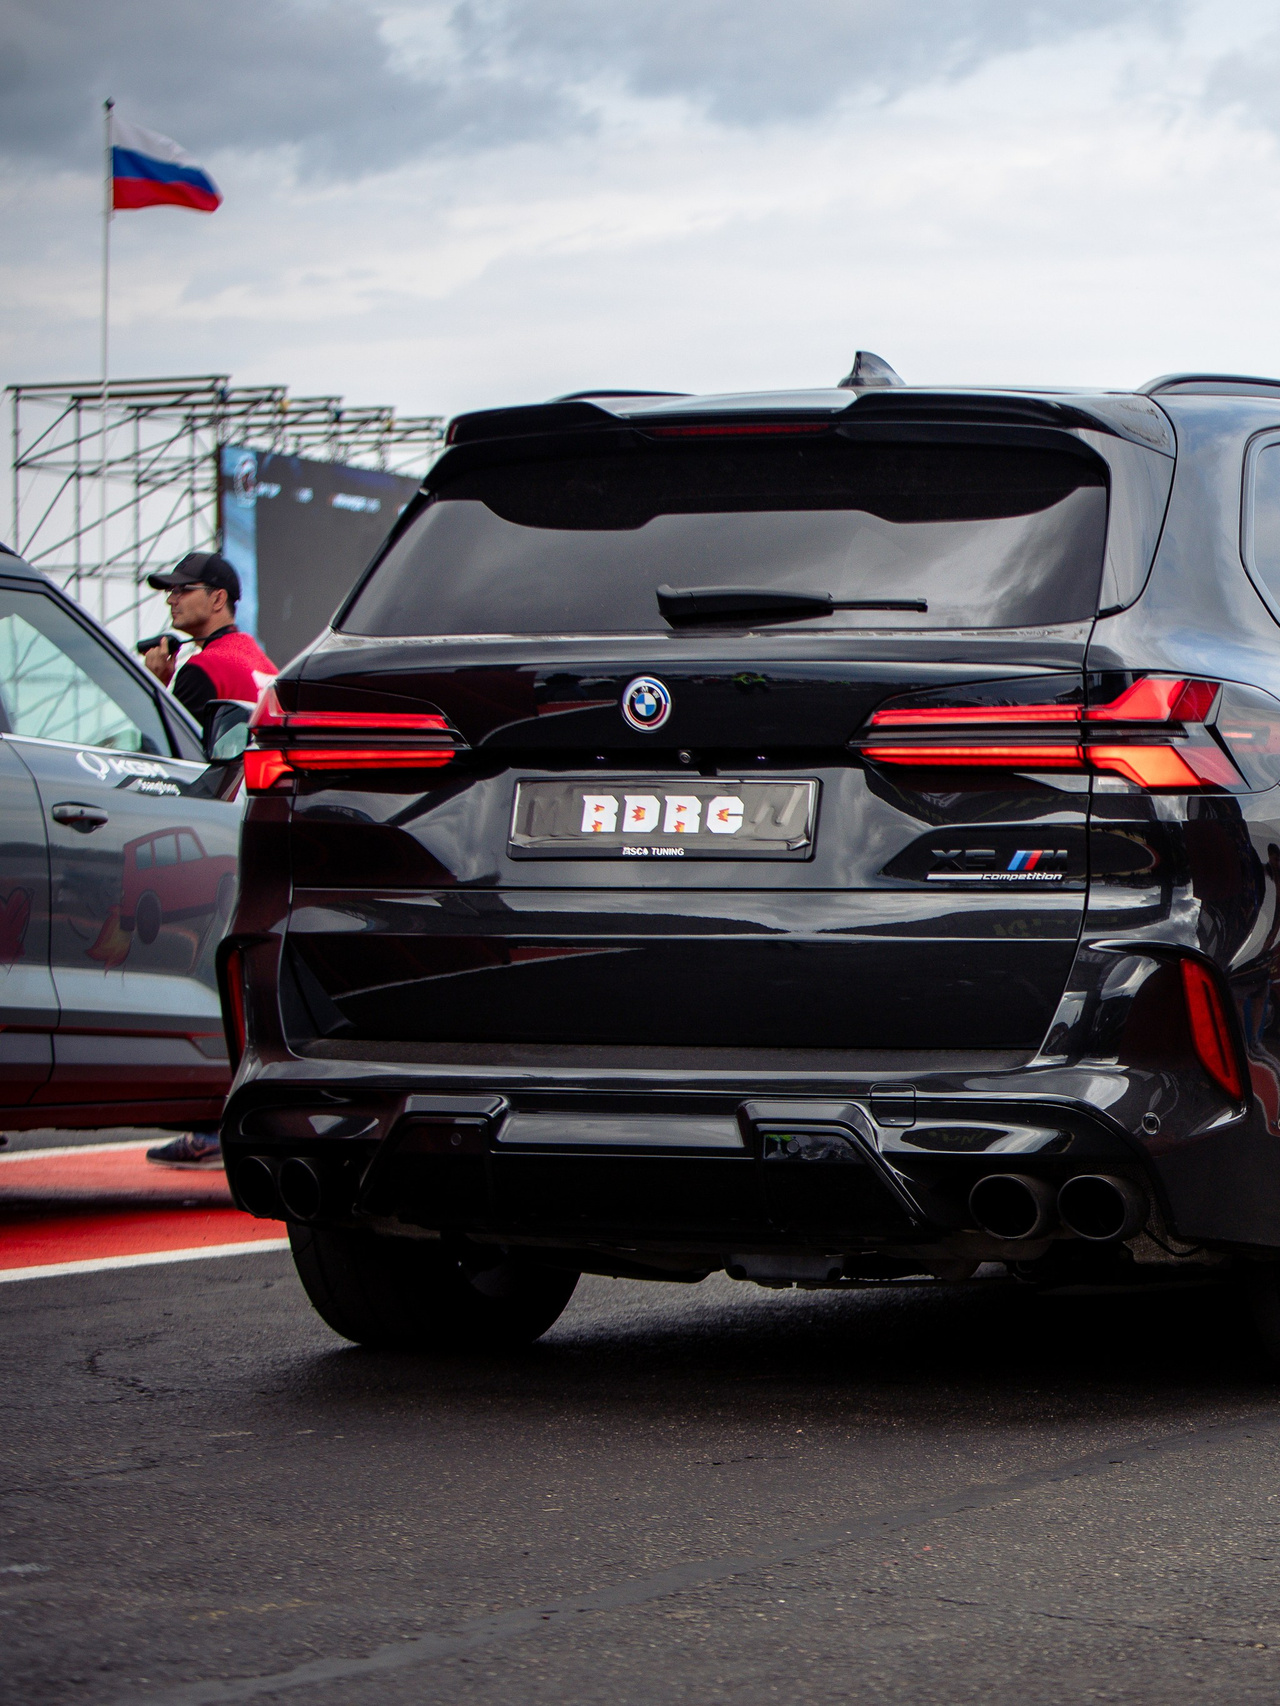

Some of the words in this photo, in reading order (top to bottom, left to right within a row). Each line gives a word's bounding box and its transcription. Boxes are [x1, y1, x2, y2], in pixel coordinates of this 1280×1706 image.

[631, 685, 661, 699] BMW
[107, 758, 170, 779] KGM
[580, 794, 745, 834] RDRC
[651, 847, 685, 856] TUNING
[928, 849, 996, 871] X5
[982, 871, 1063, 882] competition
